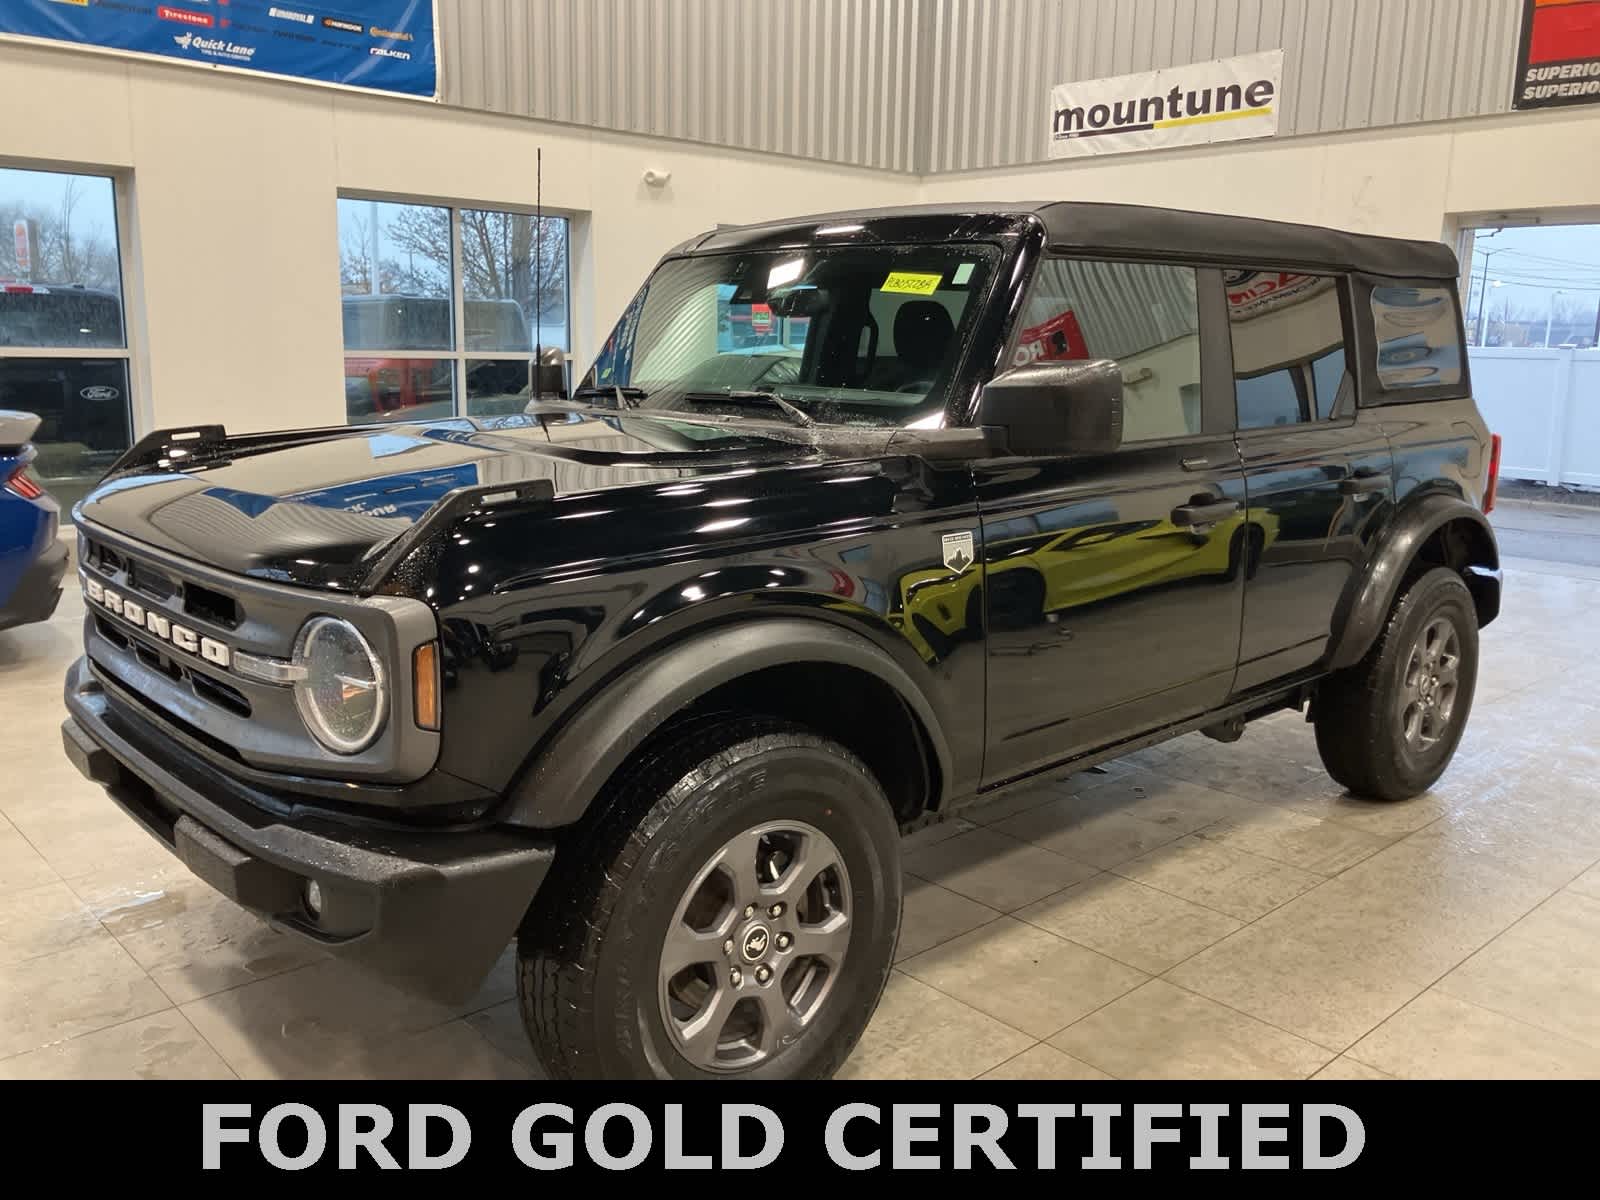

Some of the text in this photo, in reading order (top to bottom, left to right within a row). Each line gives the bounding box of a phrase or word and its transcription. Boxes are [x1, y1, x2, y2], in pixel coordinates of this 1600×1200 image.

[163, 9, 208, 24] Firestone
[191, 36, 226, 51] Quick
[226, 42, 256, 56] Lane
[370, 47, 411, 60] FALKEN
[1522, 80, 1600, 99] SUPERIO
[1053, 79, 1275, 133] mountune
[86, 577, 230, 667] BRONCO
